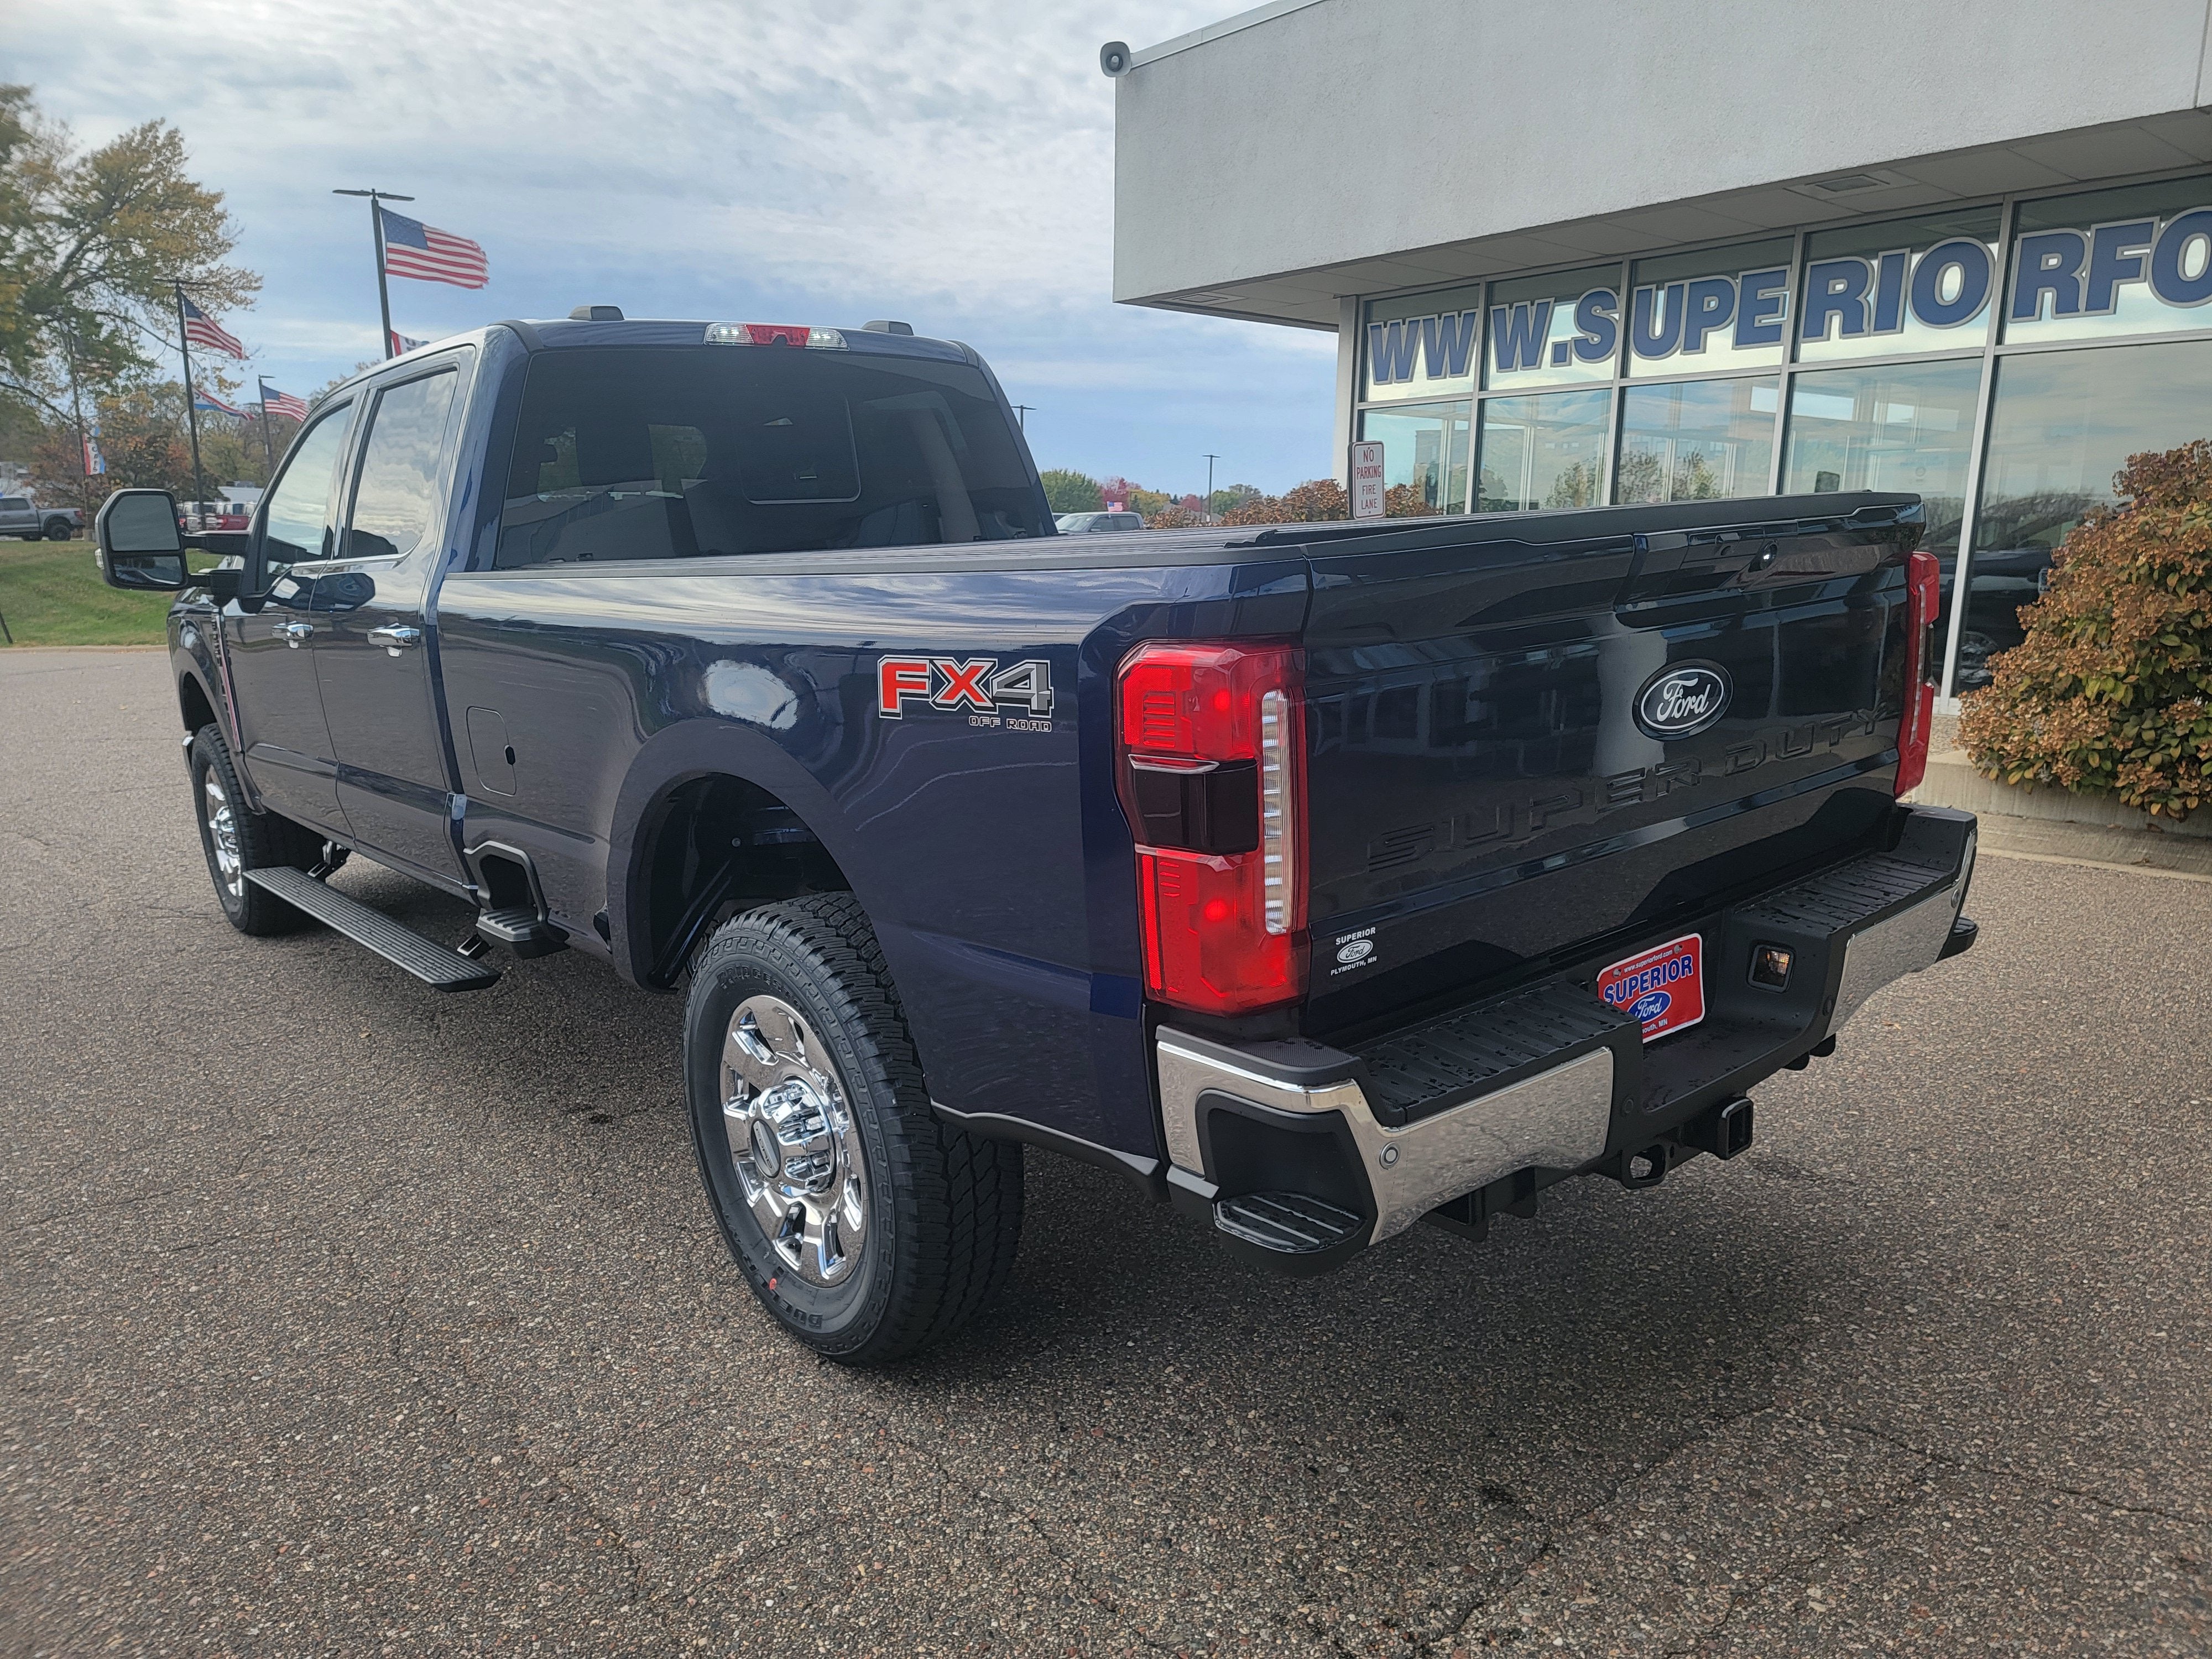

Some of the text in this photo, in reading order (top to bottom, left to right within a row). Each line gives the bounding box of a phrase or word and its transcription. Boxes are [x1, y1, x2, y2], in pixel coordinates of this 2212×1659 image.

[1363, 448, 1374, 462] NO
[1357, 465, 1381, 480] PARKING
[1362, 484, 1376, 495] FIRE
[1361, 498, 1378, 510] LANE
[878, 655, 1053, 720] FX4
[1657, 677, 1711, 722] Ford
[969, 716, 1052, 732] OFF ROAD
[1366, 702, 1887, 872] SUPER DUTY
[1335, 927, 1376, 946] SUPERIOR
[1346, 945, 1365, 958] Ford
[1331, 959, 1366, 976] PLYMOUTH,
[1624, 950, 1673, 973] www.superiorford.com
[1604, 954, 1693, 1005] SUPERIOR
[1635, 996, 1662, 1019] Ford
[1658, 1018, 1668, 1027] MN
